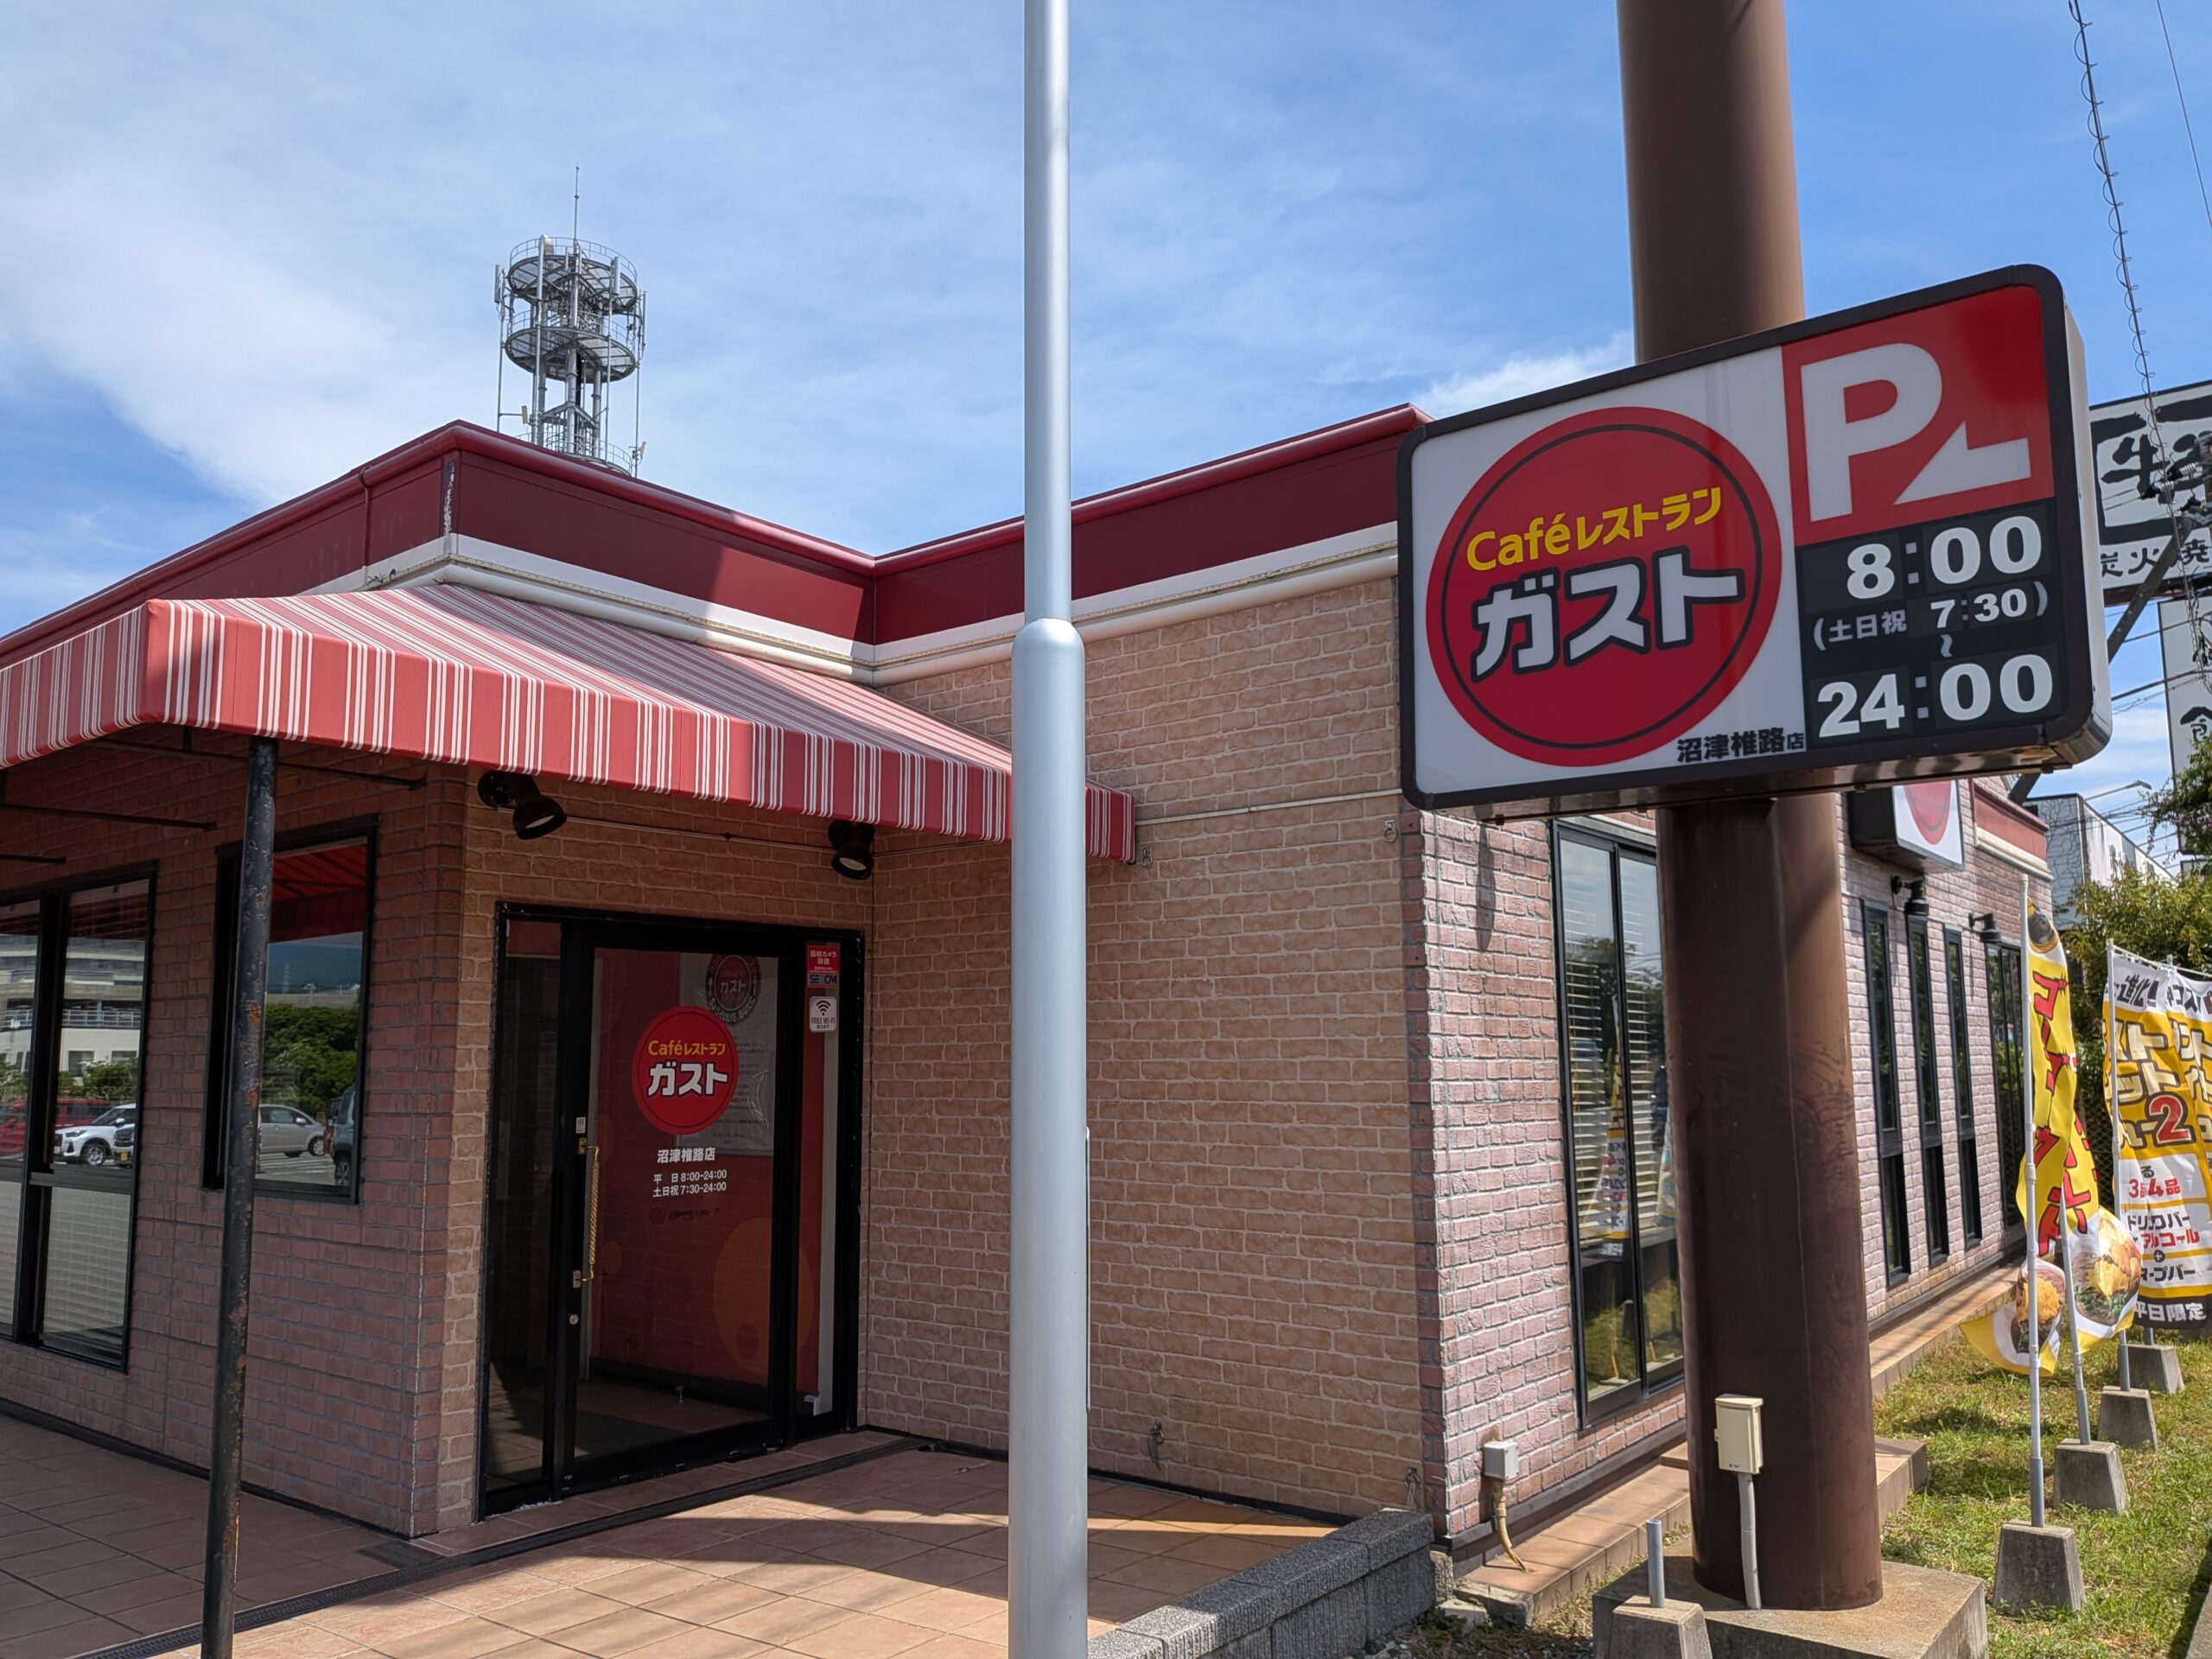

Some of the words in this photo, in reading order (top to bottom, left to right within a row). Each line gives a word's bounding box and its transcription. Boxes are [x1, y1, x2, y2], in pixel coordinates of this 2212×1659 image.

[1801, 343, 1942, 522] P
[1847, 516, 2042, 599] 8:00
[1472, 549, 1743, 681] ガスト
[1817, 654, 2053, 738] 24:00
[1677, 727, 1804, 763] 沼津椎路店
[810, 975, 837, 984] SEOM
[647, 1061, 729, 1098] ガスト
[657, 1147, 716, 1164] 沼津椎路店
[2135, 1300, 2206, 1323] 平日限定
